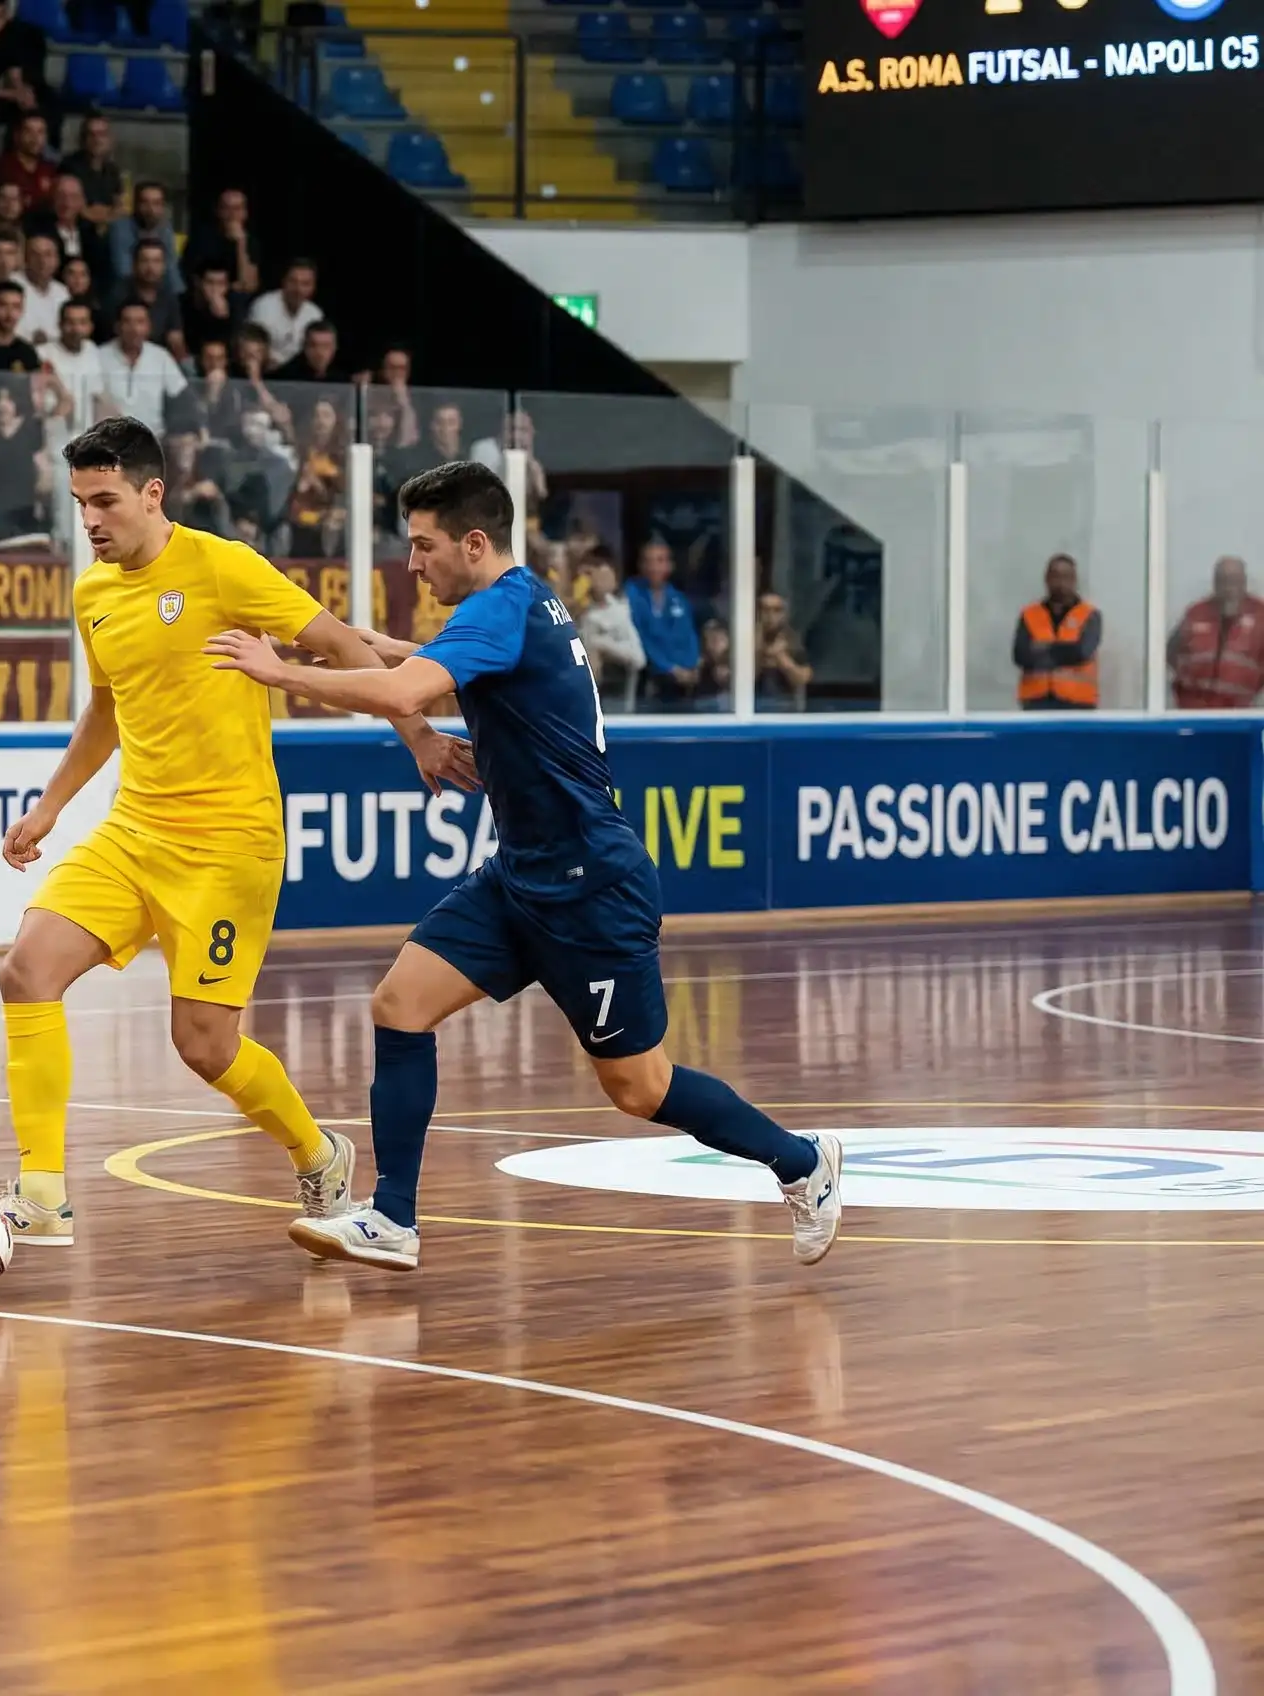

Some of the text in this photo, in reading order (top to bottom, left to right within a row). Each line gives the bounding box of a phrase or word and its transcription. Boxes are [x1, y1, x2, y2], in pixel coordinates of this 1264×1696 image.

[817, 58, 874, 94] A.S.
[879, 53, 964, 90] ROMA
[968, 46, 1081, 85] FUTSAL
[1104, 37, 1215, 78] NAPOLI
[1220, 34, 1260, 70] C5
[286, 785, 745, 882] FUTSA IVE
[798, 777, 1228, 861] PASSIONE CALCIO
[209, 919, 236, 967] 8
[589, 979, 615, 1027] 7
